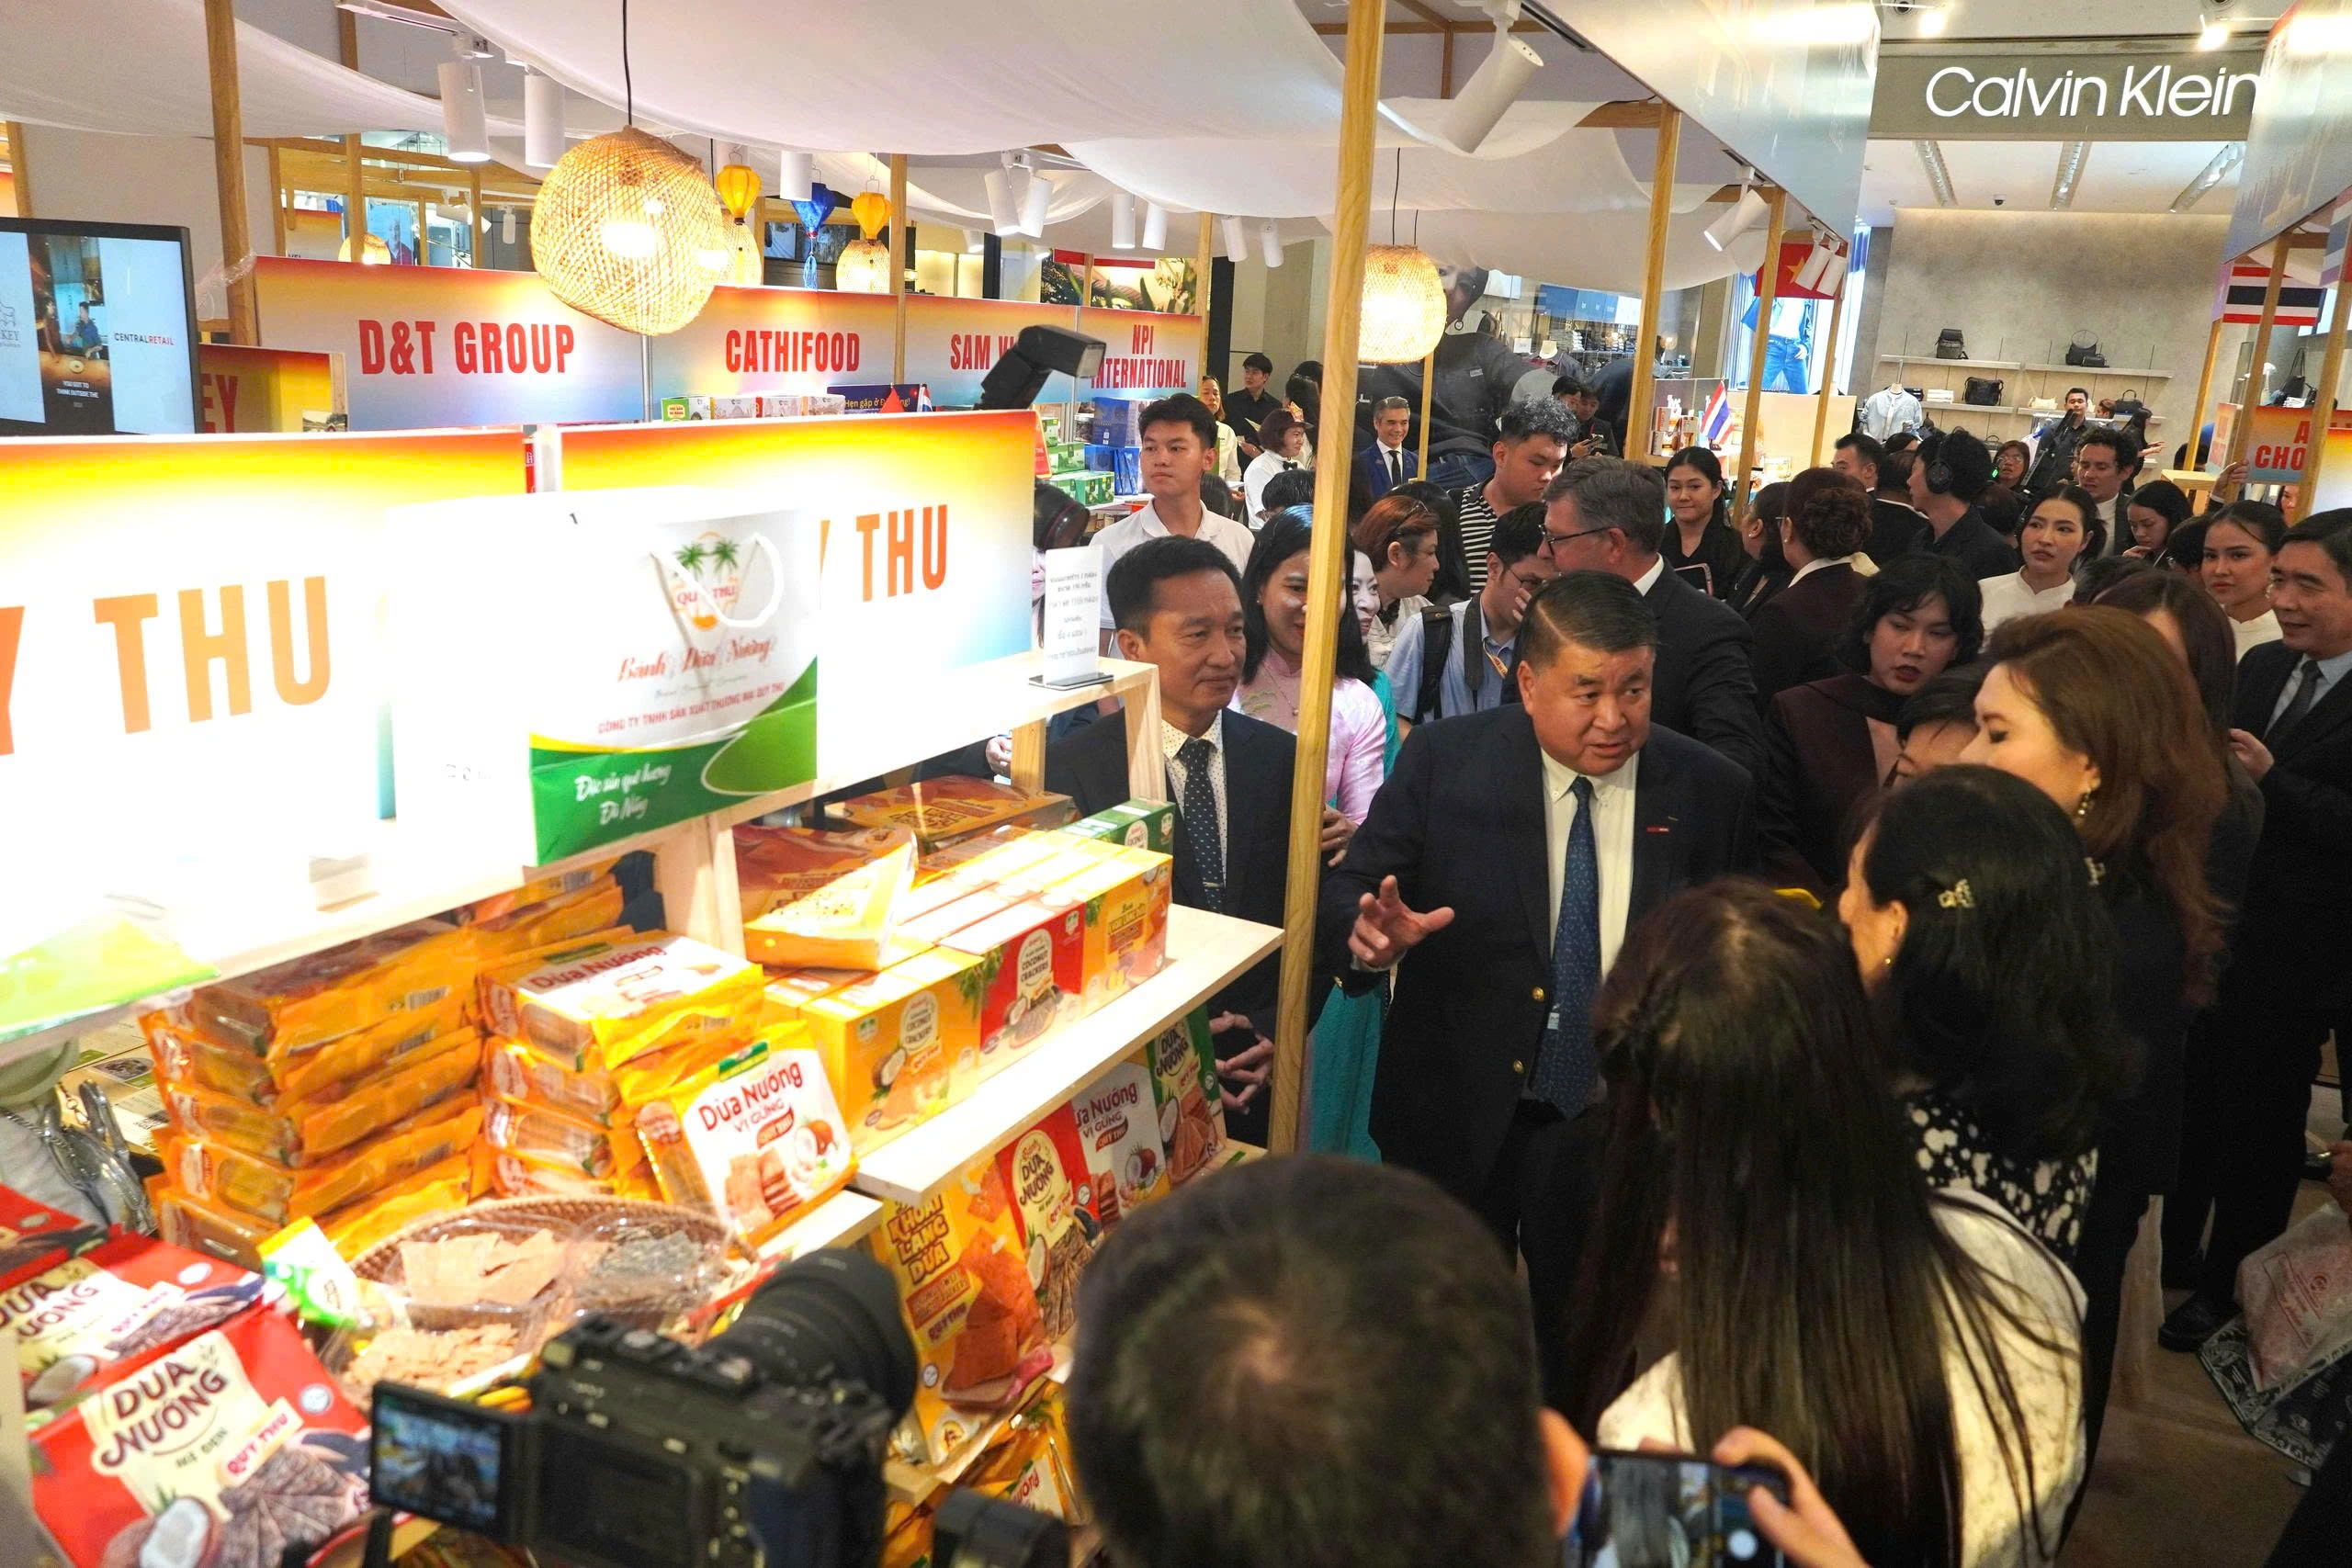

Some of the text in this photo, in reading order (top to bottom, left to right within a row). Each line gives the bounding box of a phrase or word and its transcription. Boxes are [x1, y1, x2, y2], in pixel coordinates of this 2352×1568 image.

[1926, 64, 2262, 118] Calvin Klein
[358, 319, 574, 376] D&T GROUP
[725, 329, 861, 373] CATHIFOOD
[950, 333, 991, 370] SAM
[1132, 324, 1154, 355] NPI
[855, 504, 948, 603] THU
[94, 576, 331, 734] THU
